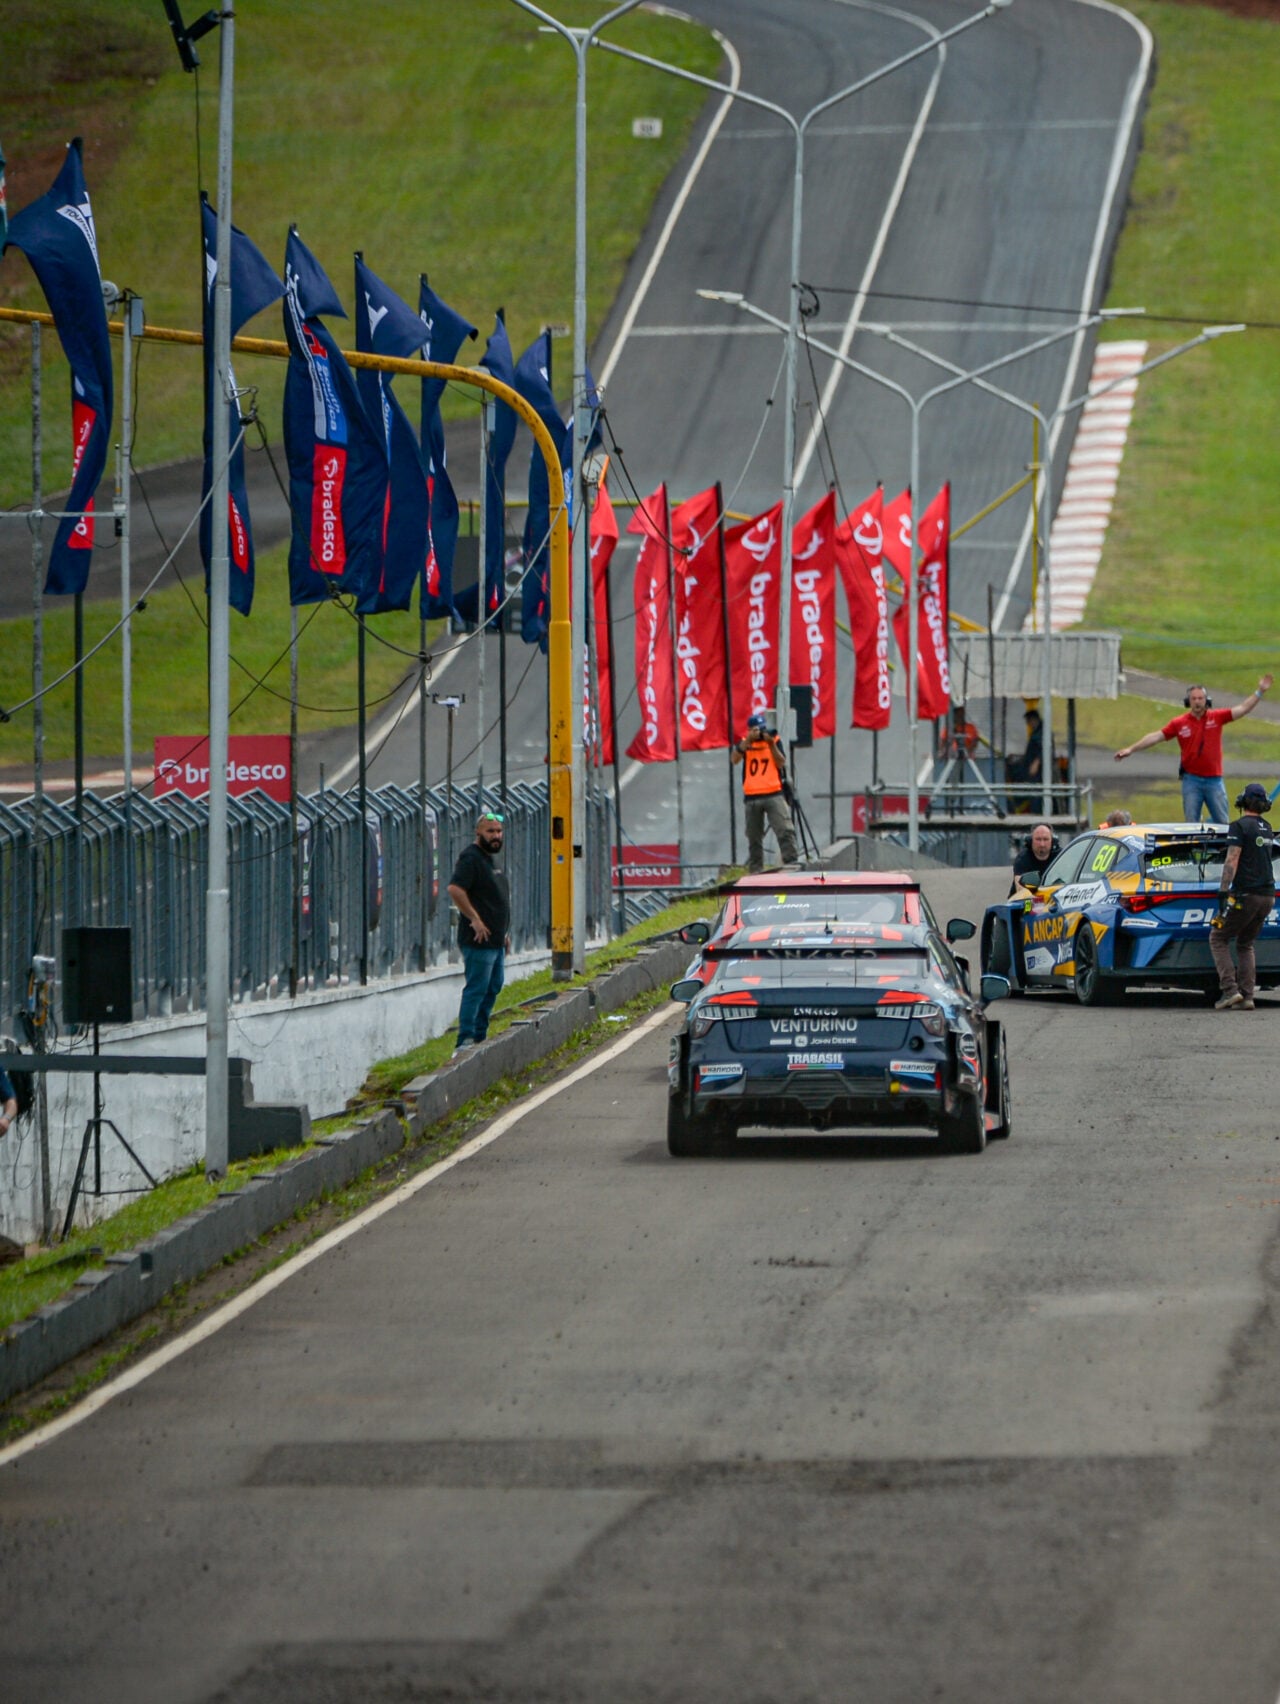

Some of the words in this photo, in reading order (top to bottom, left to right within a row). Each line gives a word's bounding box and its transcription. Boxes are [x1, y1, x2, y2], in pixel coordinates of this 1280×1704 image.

[321, 480, 336, 563] bradesco
[185, 760, 287, 784] brdesco
[750, 757, 769, 776] 07
[1091, 844, 1118, 873] 60
[1151, 856, 1172, 868] 60
[1062, 884, 1102, 906] Planet
[1181, 907, 1280, 928] Plt
[1033, 914, 1065, 943] ANCAP
[770, 1018, 859, 1033] VENTURINO
[787, 1052, 845, 1065] TRABASIL
